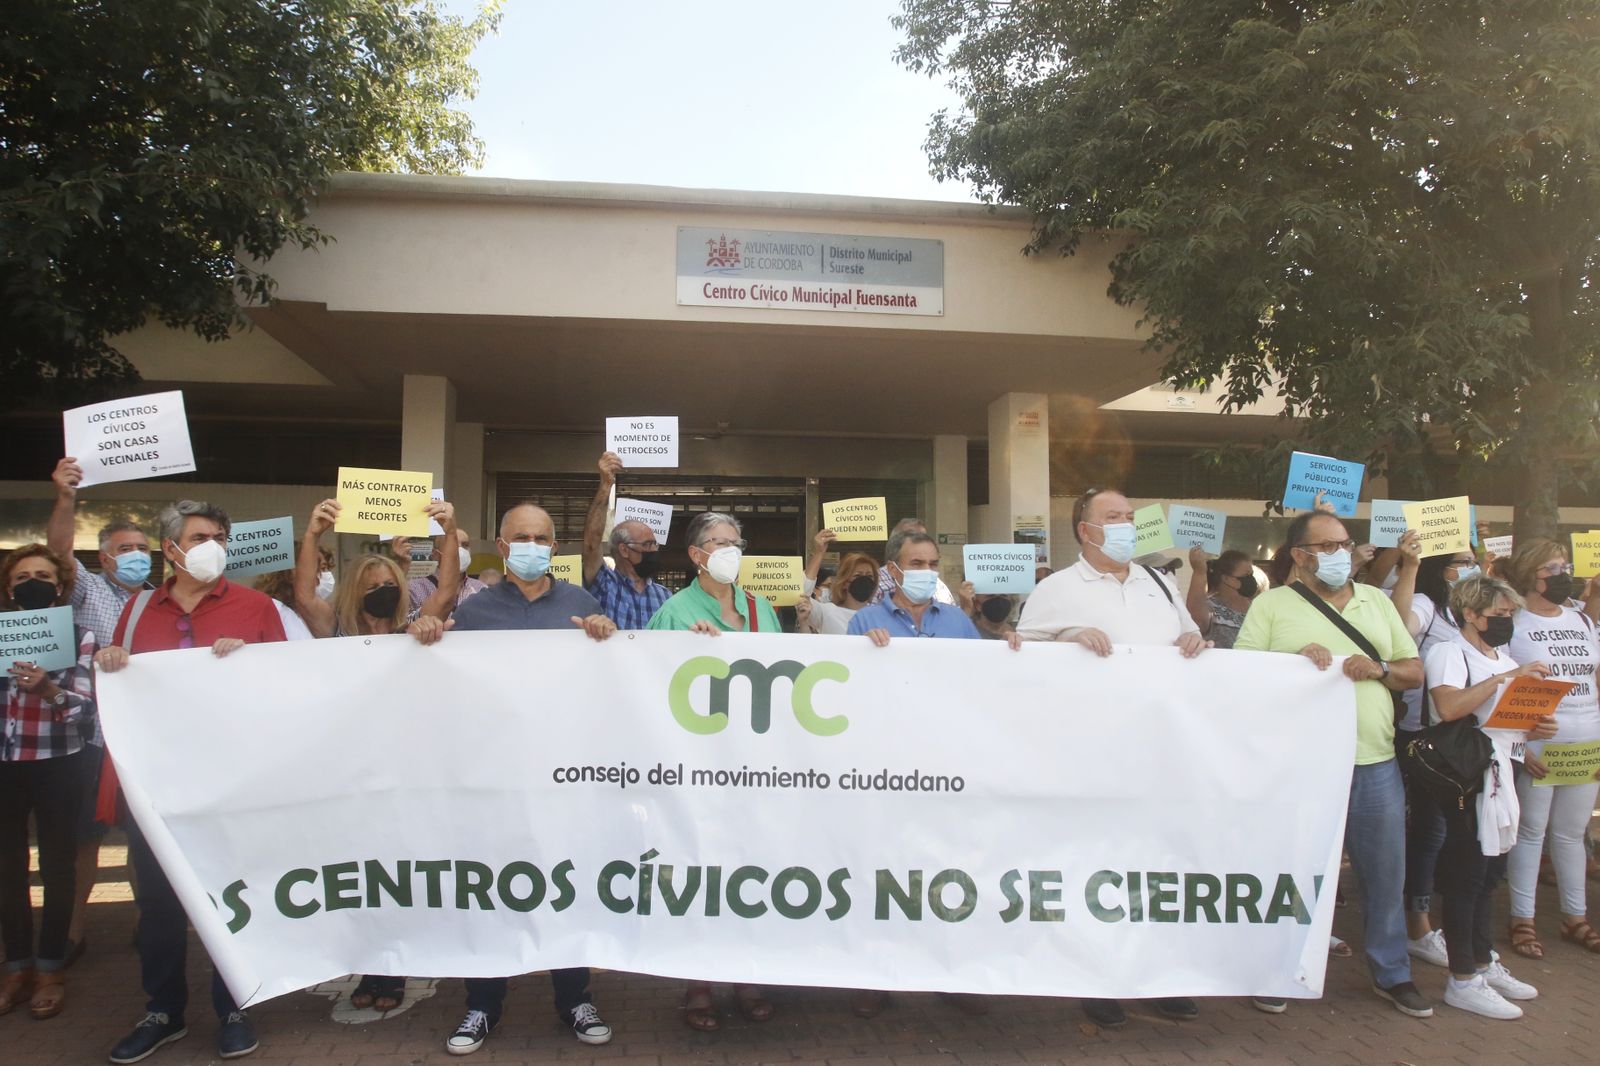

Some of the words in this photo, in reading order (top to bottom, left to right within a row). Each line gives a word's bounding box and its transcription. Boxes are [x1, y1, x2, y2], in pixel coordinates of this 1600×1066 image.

[744, 242, 814, 257] AYUNTAMIENTO
[829, 246, 865, 260] Distrito
[867, 250, 912, 264] Municipal
[744, 257, 756, 269] DE
[829, 261, 865, 275] Sureste
[703, 282, 746, 300] Centro
[749, 283, 788, 302] Cívico
[792, 286, 852, 307] Municipal
[856, 289, 918, 307] Fuensanta
[88, 412, 106, 423] LOS
[109, 405, 158, 420] CENTROS
[103, 421, 146, 435] CÍVICOS
[630, 422, 643, 430] NO
[645, 422, 655, 430] ES
[98, 439, 121, 451] SON
[124, 435, 159, 448] CASAS
[614, 434, 659, 442] MOMENTO
[660, 434, 671, 442] DE
[100, 450, 159, 466] VECINALES
[1309, 461, 1347, 474] SERVICIOS
[1304, 471, 1340, 485] PÚBLICOS
[342, 479, 365, 490] MÁS
[367, 482, 427, 494] CONTRATOS
[365, 496, 402, 507] MENOS
[846, 504, 878, 512] CENTROS
[637, 507, 664, 517] CENTROS
[1183, 510, 1215, 520] ATENCIÓN
[1421, 503, 1455, 515] ATENCIÓN
[358, 511, 407, 522] RECORTES
[1374, 515, 1407, 523] CONTRATA
[1421, 516, 1458, 527] PRESENCIAL
[1136, 518, 1163, 531] ACIONES
[1180, 519, 1215, 530] PRESENCIAL
[235, 527, 282, 542] CENTROS
[1176, 528, 1216, 540] ELECTRÓNICA
[1419, 528, 1460, 541] ELECTRÓNICA
[227, 544, 260, 557] ÍVICOS
[262, 542, 278, 551] NO
[1432, 542, 1447, 551] ¡NO!
[226, 559, 252, 571] EDEN
[255, 553, 288, 565] MORIR
[968, 553, 1002, 561] CENTROS
[1003, 551, 1033, 561] CÍVICOS
[756, 561, 789, 569] SERVICIOS
[976, 564, 1025, 572] REFORZADOS
[0, 614, 48, 628] TENCIÓN
[0, 629, 55, 643] RESENCIAL
[1528, 630, 1548, 641] LOS
[0, 643, 60, 657] ECTRÓNICA
[1548, 643, 1589, 657] CÍVICOS
[1561, 663, 1595, 676] PUEDEN
[1513, 686, 1527, 694] LOS
[1537, 699, 1550, 707] NO
[1495, 711, 1526, 720] PUEDEN
[552, 761, 641, 789] consejo
[647, 762, 683, 785] del
[692, 766, 831, 789] movimiento
[839, 768, 964, 792] ciudadano
[275, 859, 576, 919] CENTROS
[597, 848, 852, 921] CÍVICOS
[875, 868, 978, 923] NO
[998, 868, 1066, 924] SE
[1084, 869, 1324, 925] CIERRA
